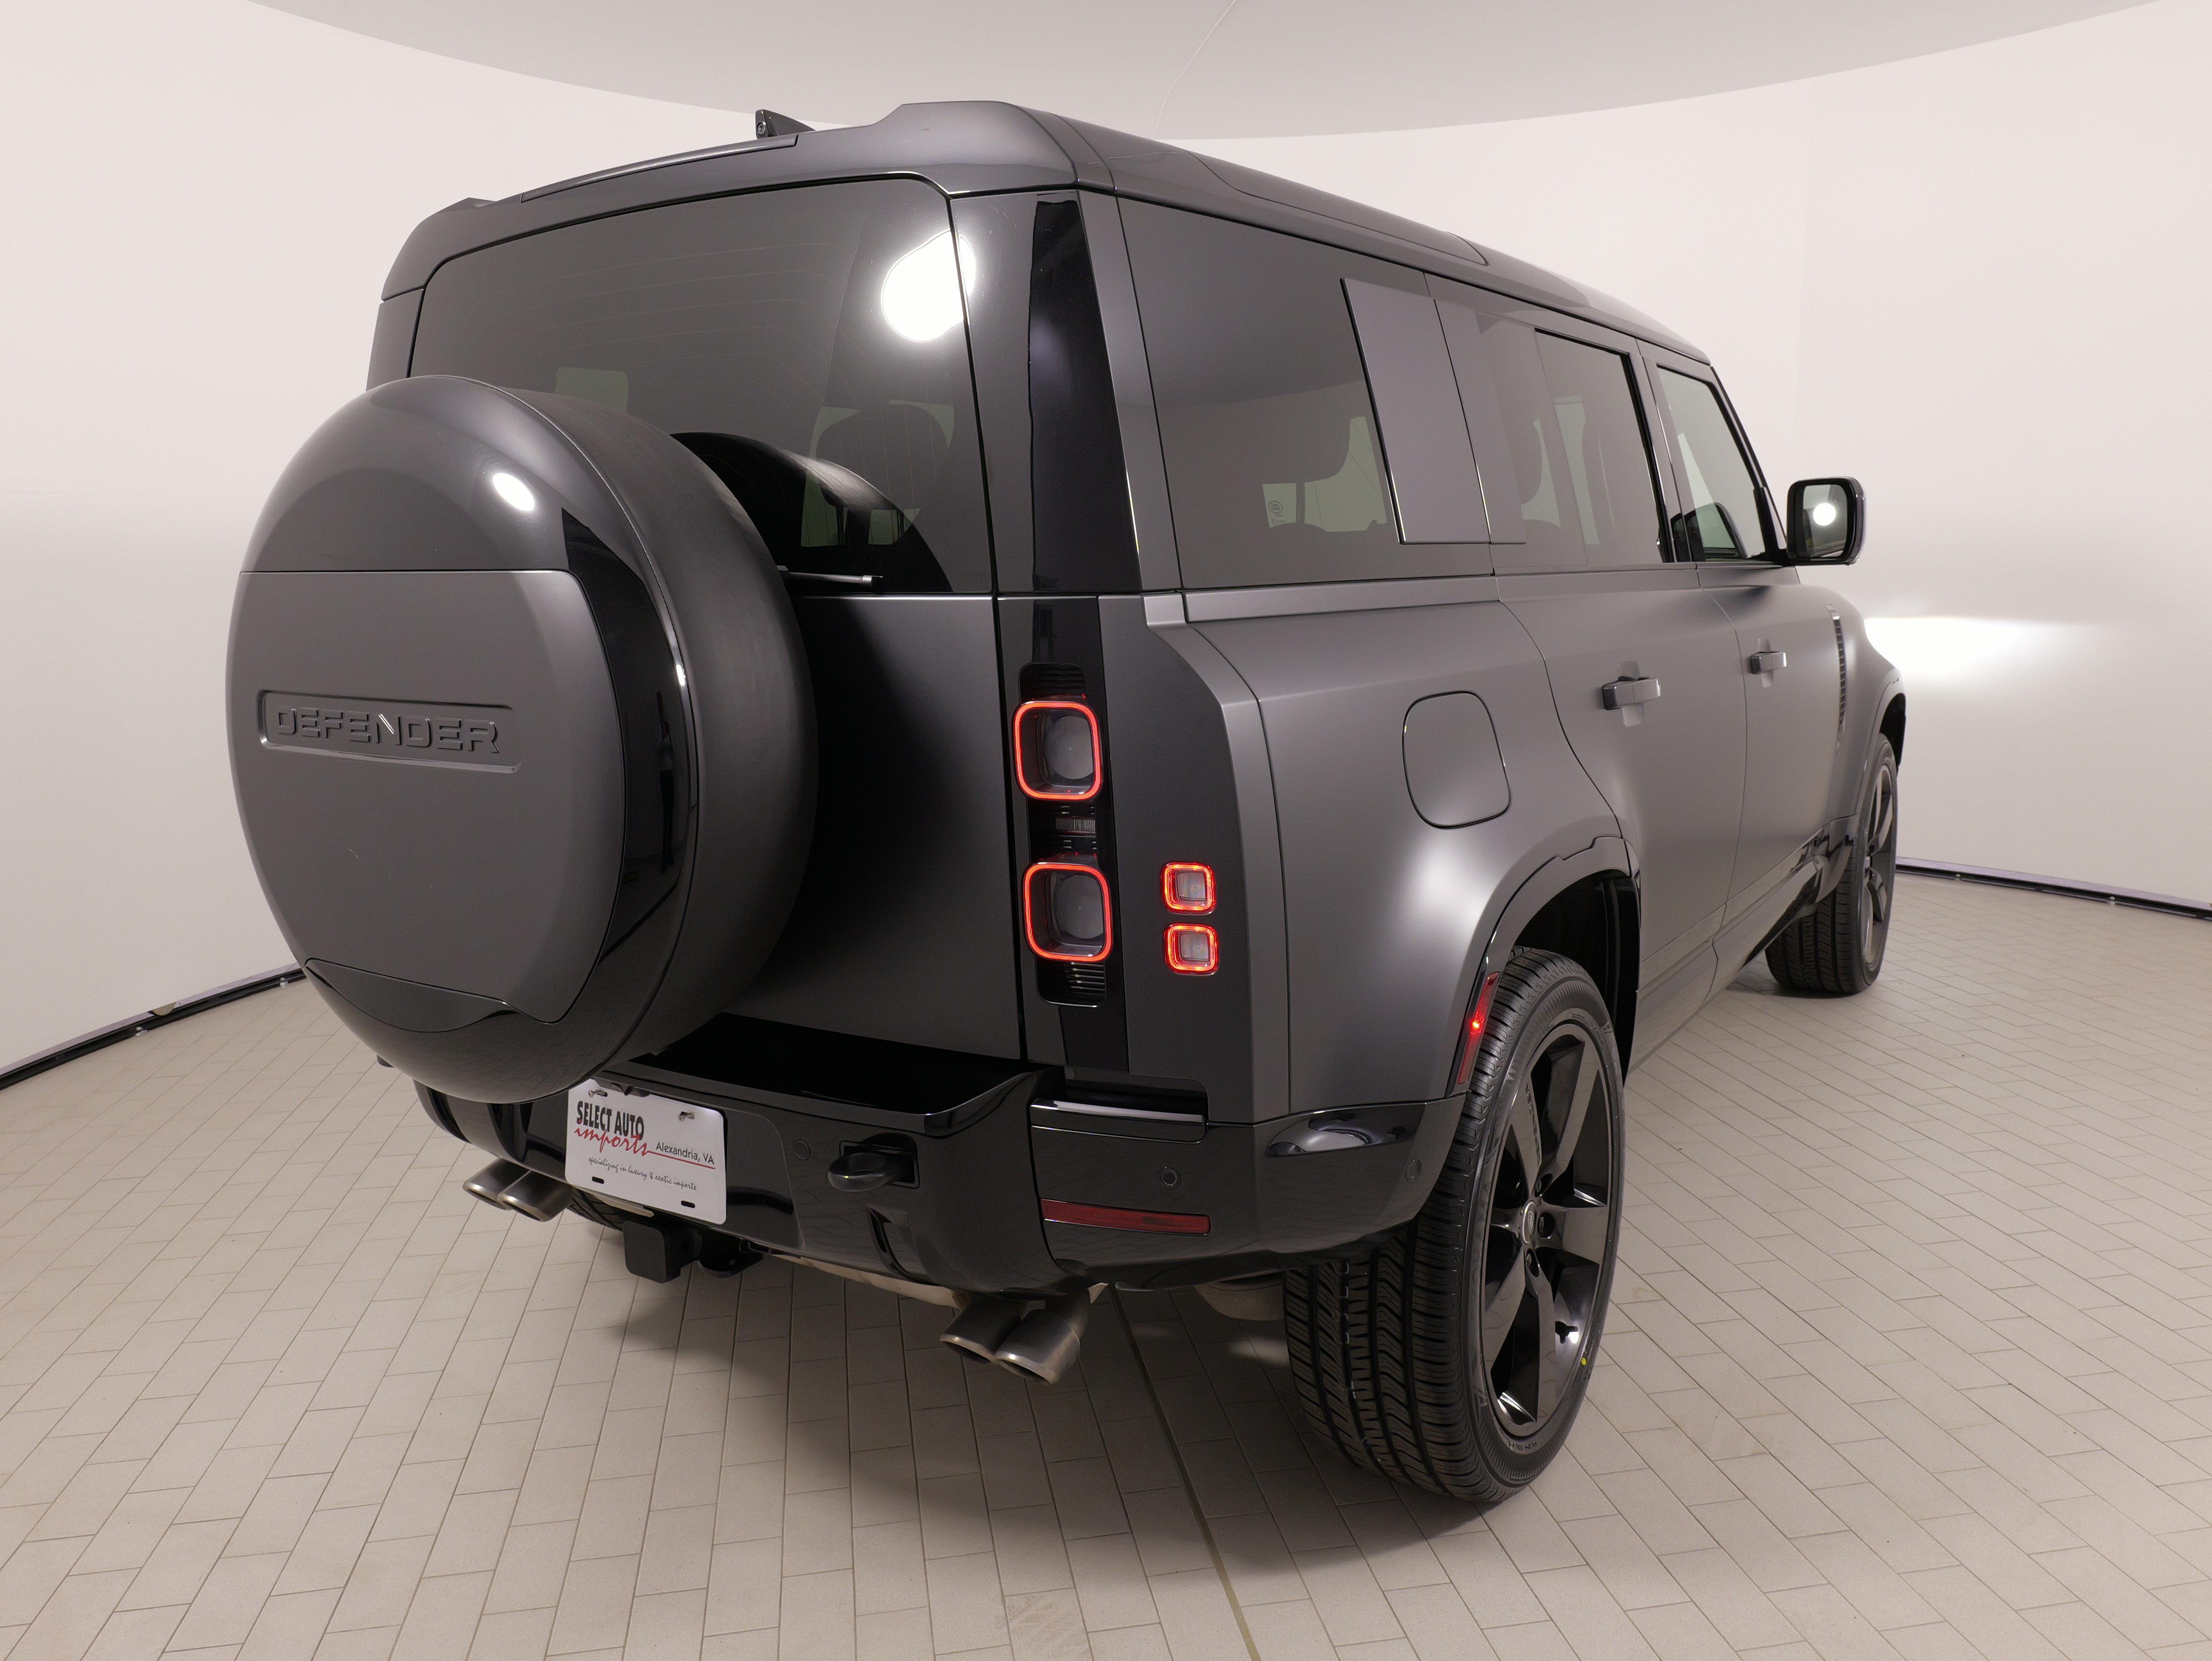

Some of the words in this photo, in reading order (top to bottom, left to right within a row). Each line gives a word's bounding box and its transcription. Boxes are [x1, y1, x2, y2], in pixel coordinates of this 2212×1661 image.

[274, 706, 500, 753] DEFENDER
[576, 1100, 612, 1135] SELECT
[614, 1110, 644, 1141] AUTO
[574, 1127, 648, 1156] imports
[656, 1141, 701, 1162] Alexandria,
[703, 1153, 715, 1165] VA
[628, 1165, 648, 1181] luxury
[673, 1179, 697, 1191] imports
